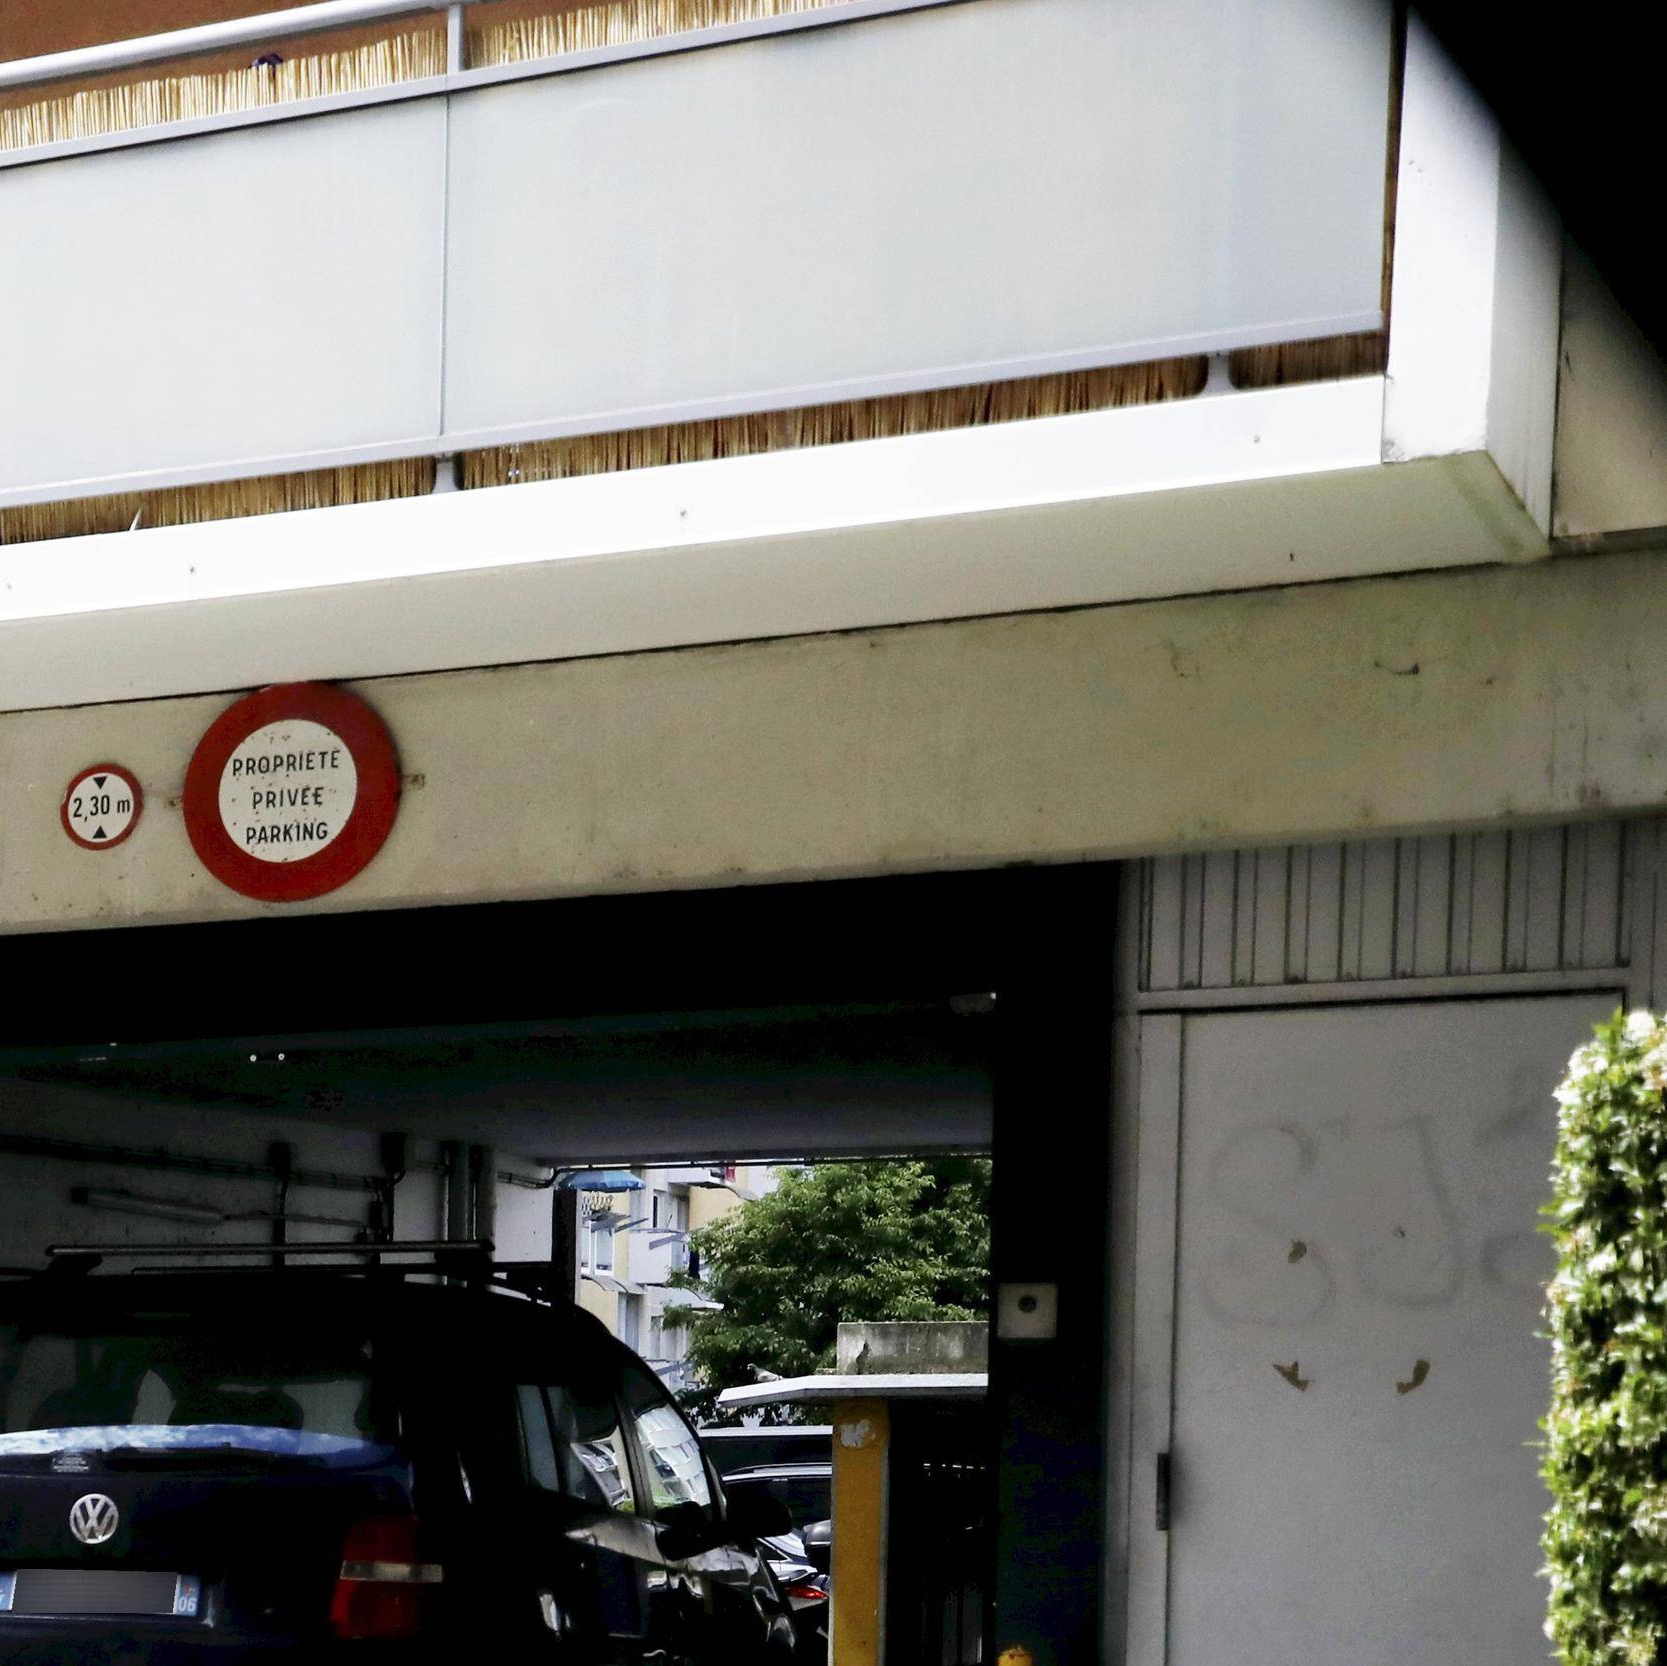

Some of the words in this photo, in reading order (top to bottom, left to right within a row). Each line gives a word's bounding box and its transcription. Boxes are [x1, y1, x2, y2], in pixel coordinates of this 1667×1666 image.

[72, 793, 111, 823] 2,30
[116, 798, 131, 814] m
[246, 821, 329, 845] PARKING
[178, 1597, 197, 1612] 06
